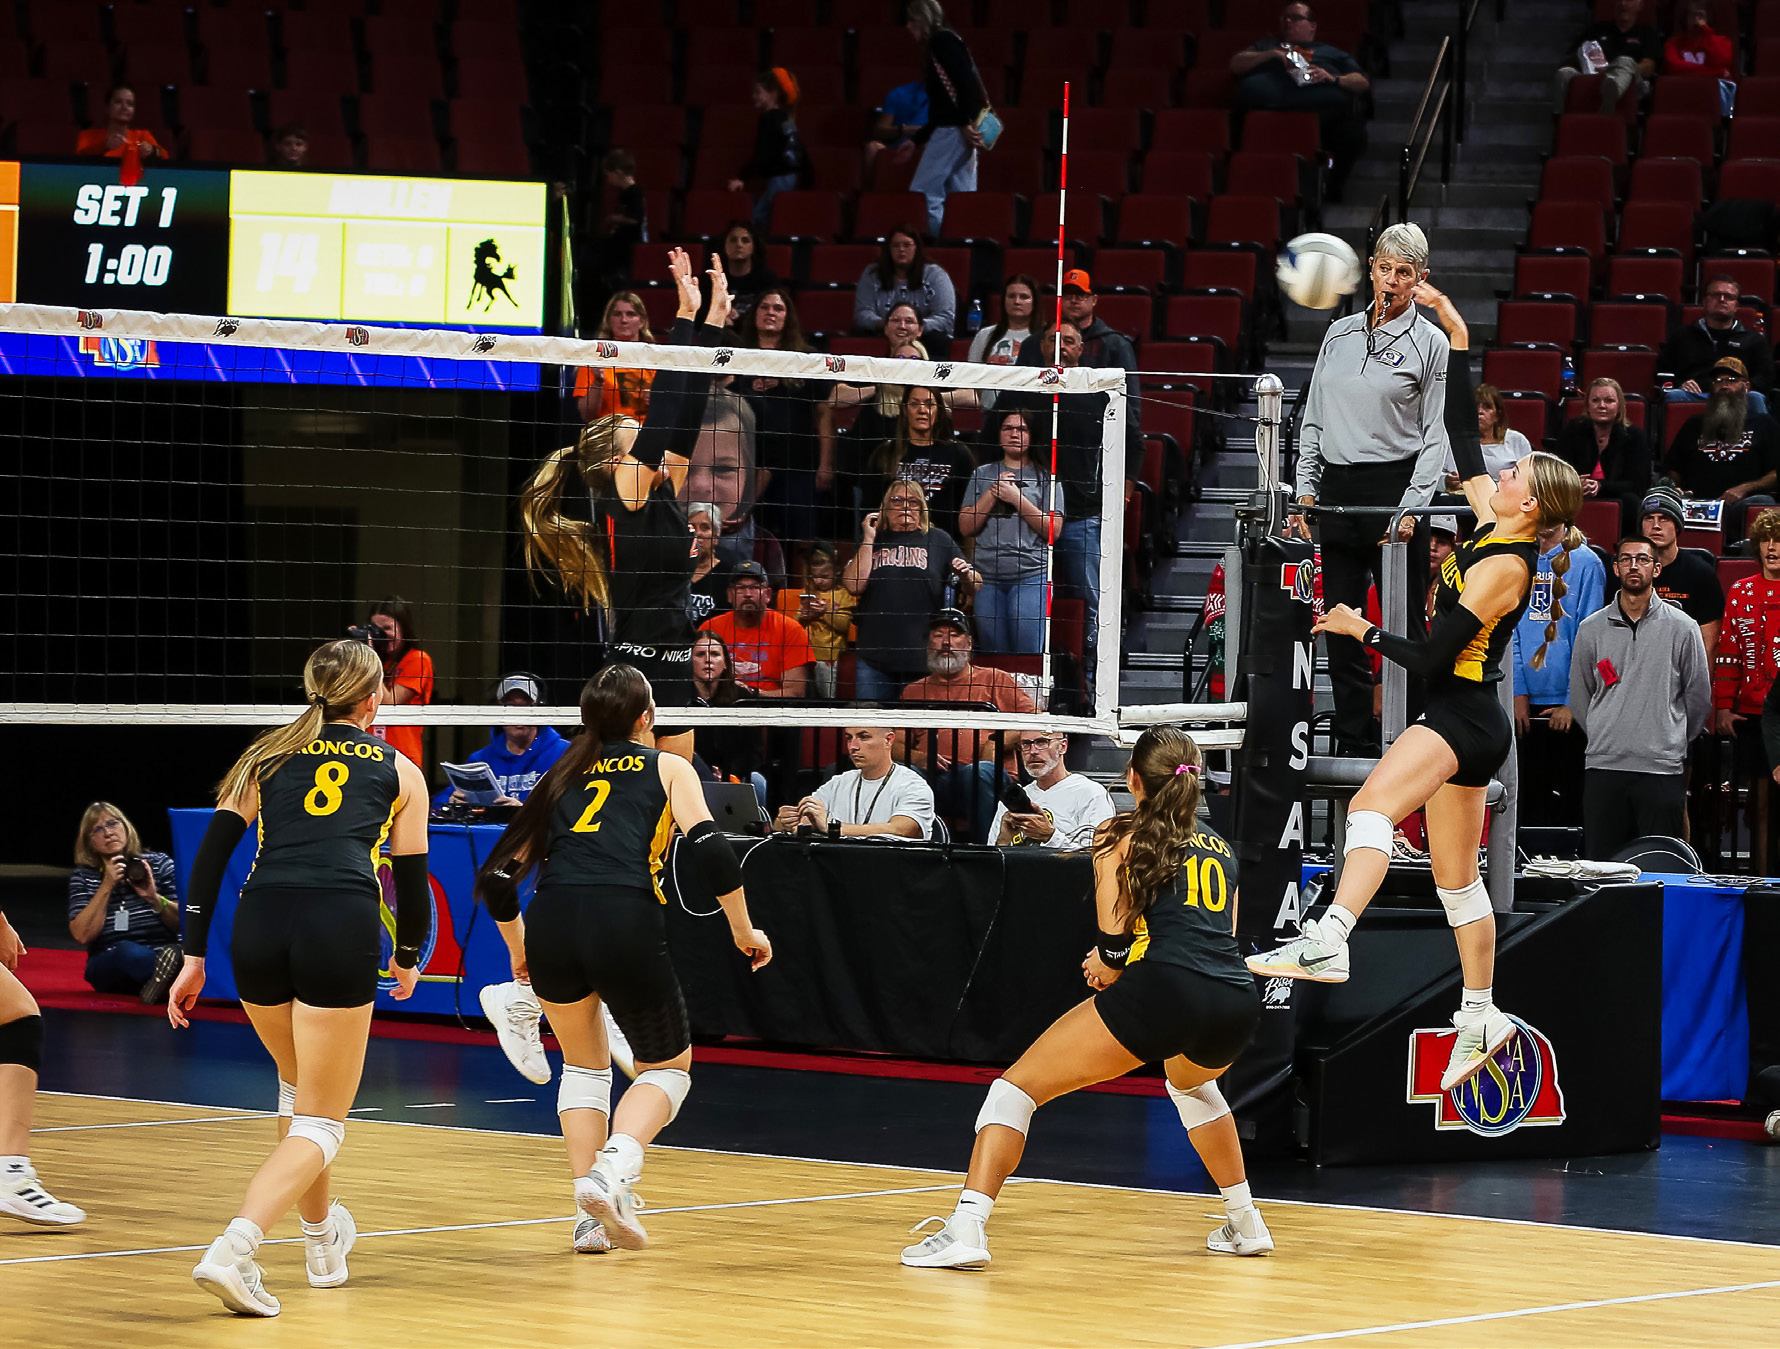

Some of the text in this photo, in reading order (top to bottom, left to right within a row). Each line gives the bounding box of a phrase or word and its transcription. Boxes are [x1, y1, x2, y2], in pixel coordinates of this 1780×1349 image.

[73, 184, 178, 228] SET 1
[84, 242, 173, 286] 1:00
[255, 231, 321, 295] 14
[872, 545, 928, 571] TROJANS
[298, 739, 385, 762] ONCOS
[303, 760, 350, 816] 8
[569, 779, 611, 833] 2
[1182, 854, 1227, 912] 10
